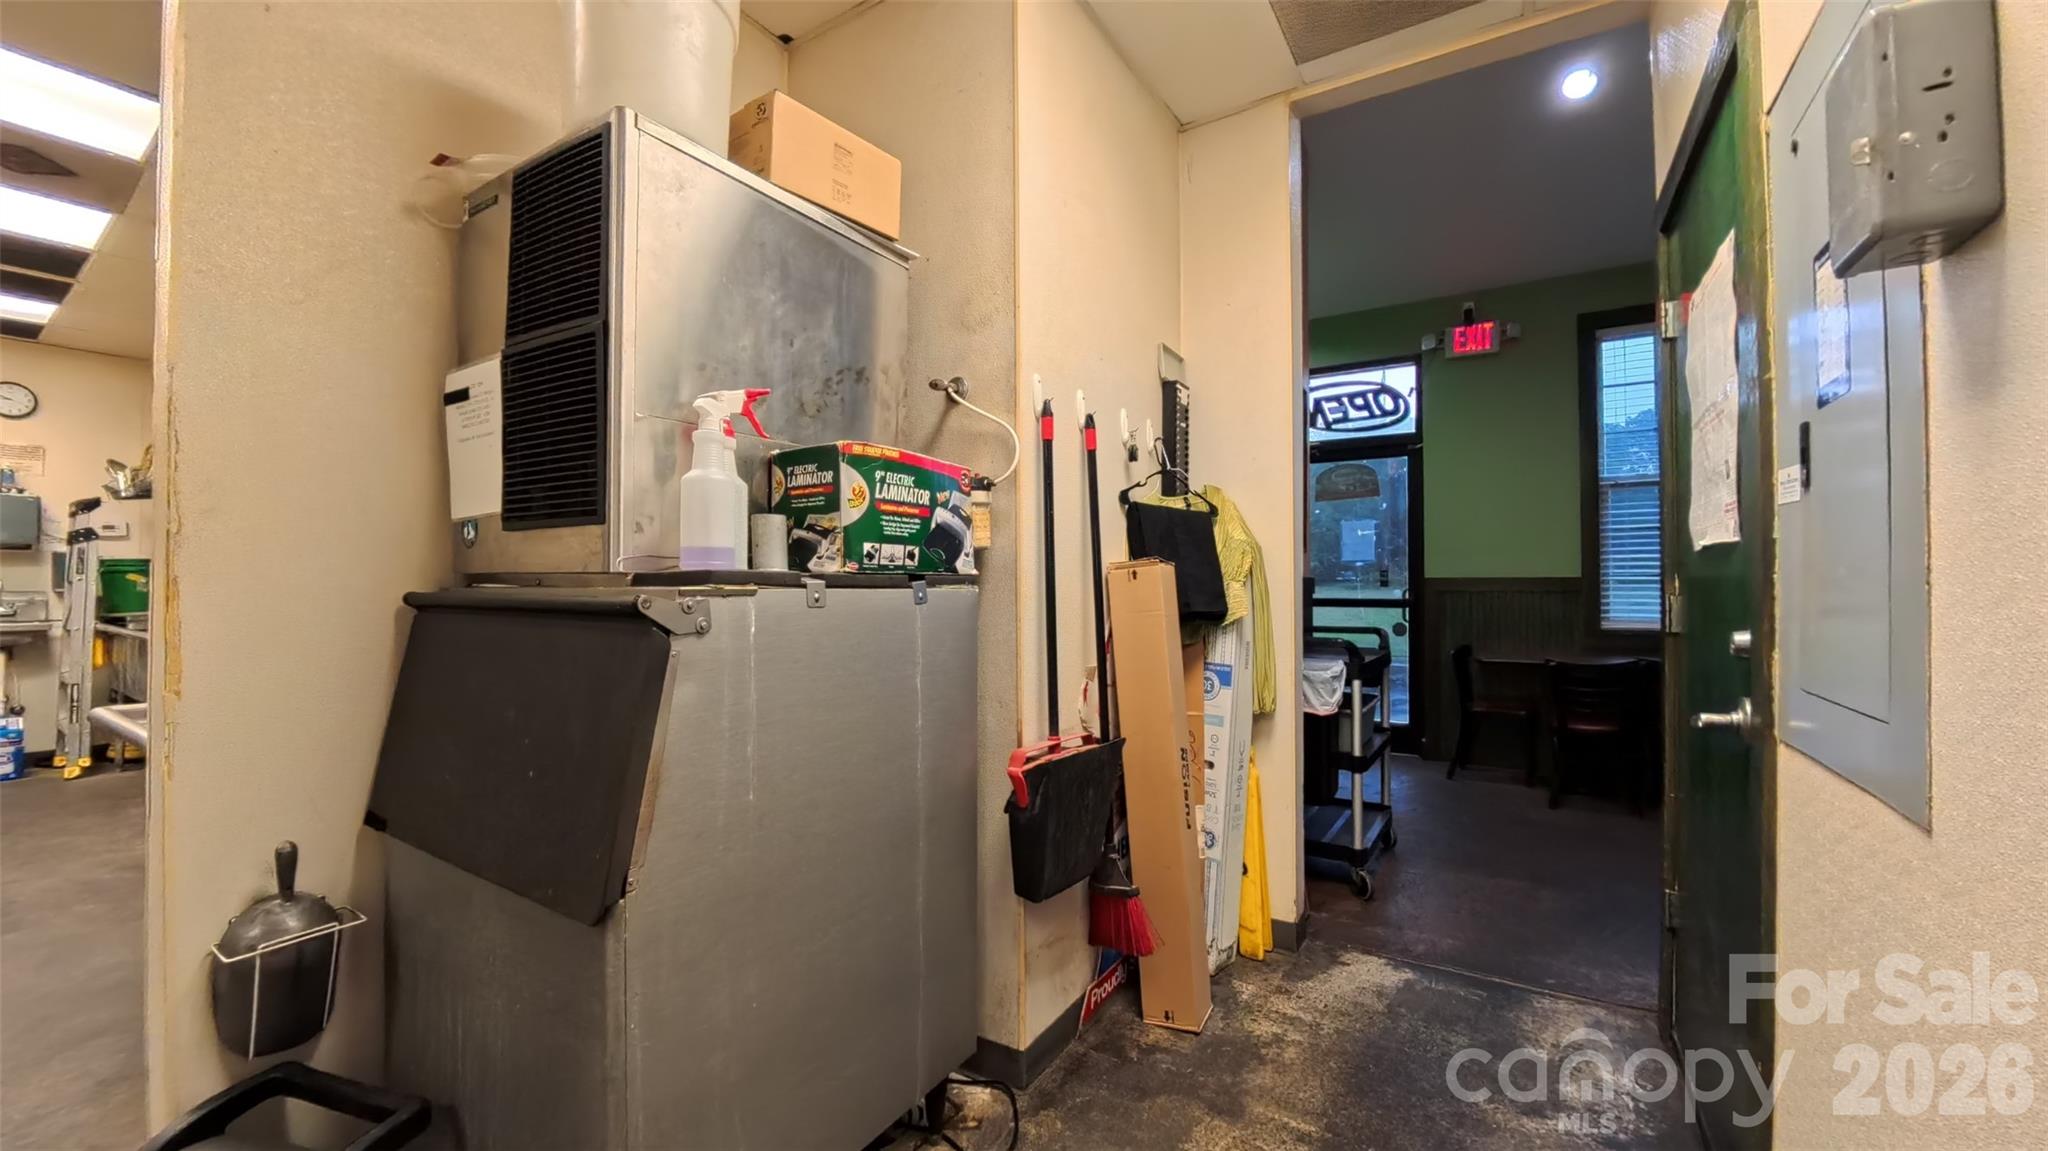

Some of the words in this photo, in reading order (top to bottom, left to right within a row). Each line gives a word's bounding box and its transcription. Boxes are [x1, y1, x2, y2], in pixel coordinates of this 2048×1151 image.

[1453, 321, 1495, 353] EXIT
[787, 470, 834, 488] LAMINATOR
[886, 471, 915, 487] ELECTRIC
[875, 482, 931, 506] LAMINATOR
